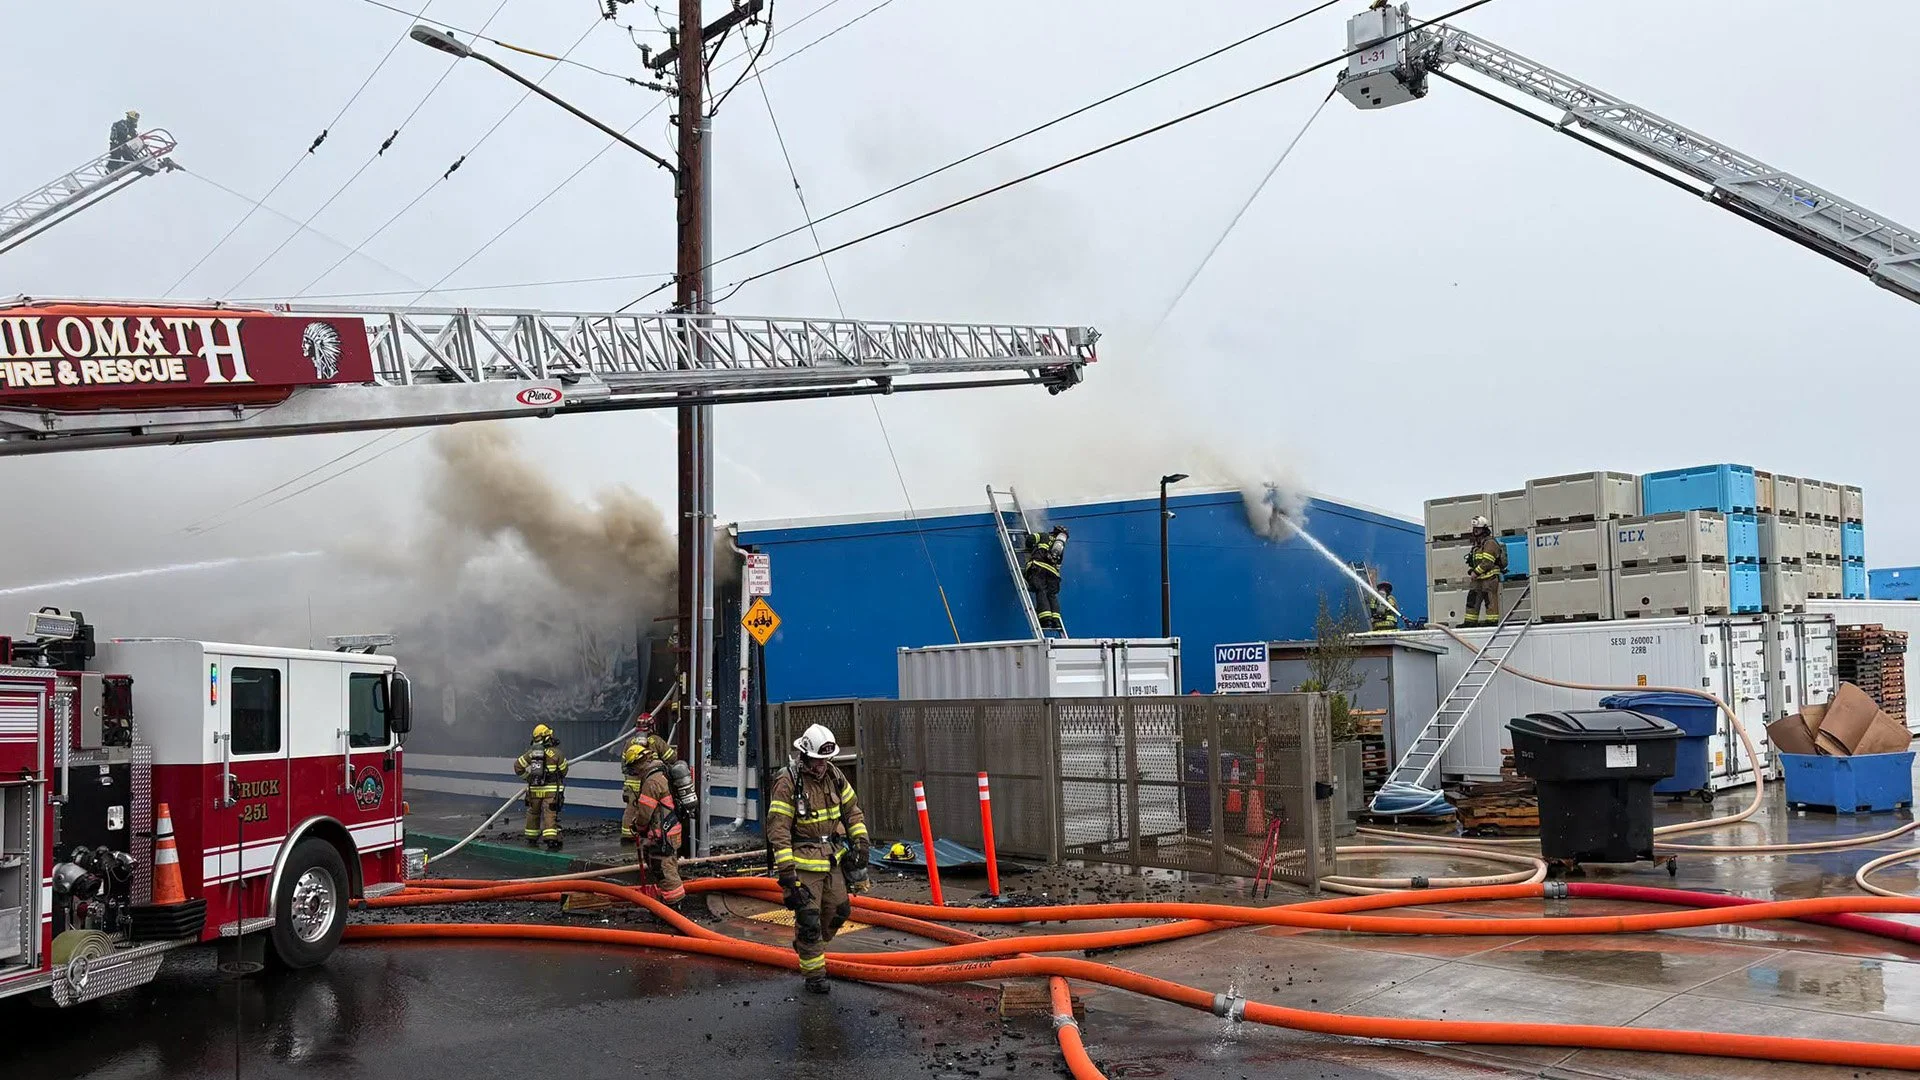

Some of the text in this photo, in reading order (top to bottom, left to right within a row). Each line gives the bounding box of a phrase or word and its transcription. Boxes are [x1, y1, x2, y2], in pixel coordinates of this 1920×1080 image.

[1360, 49, 1386, 65] L-31
[57, 359, 80, 385] &
[80, 358, 188, 384] RESCUE
[527, 389, 553, 402] Pierce
[1536, 534, 1560, 547] CCX
[1619, 529, 1645, 543] CCX
[1610, 637, 1627, 646] SESU
[1218, 647, 1264, 661] NOTICE
[1222, 664, 1259, 673] AUTHORIZED
[1221, 672, 1262, 681] VEHICLES AND
[1217, 681, 1267, 690] PERSONNEL ONLY
[244, 803, 268, 822] 251
